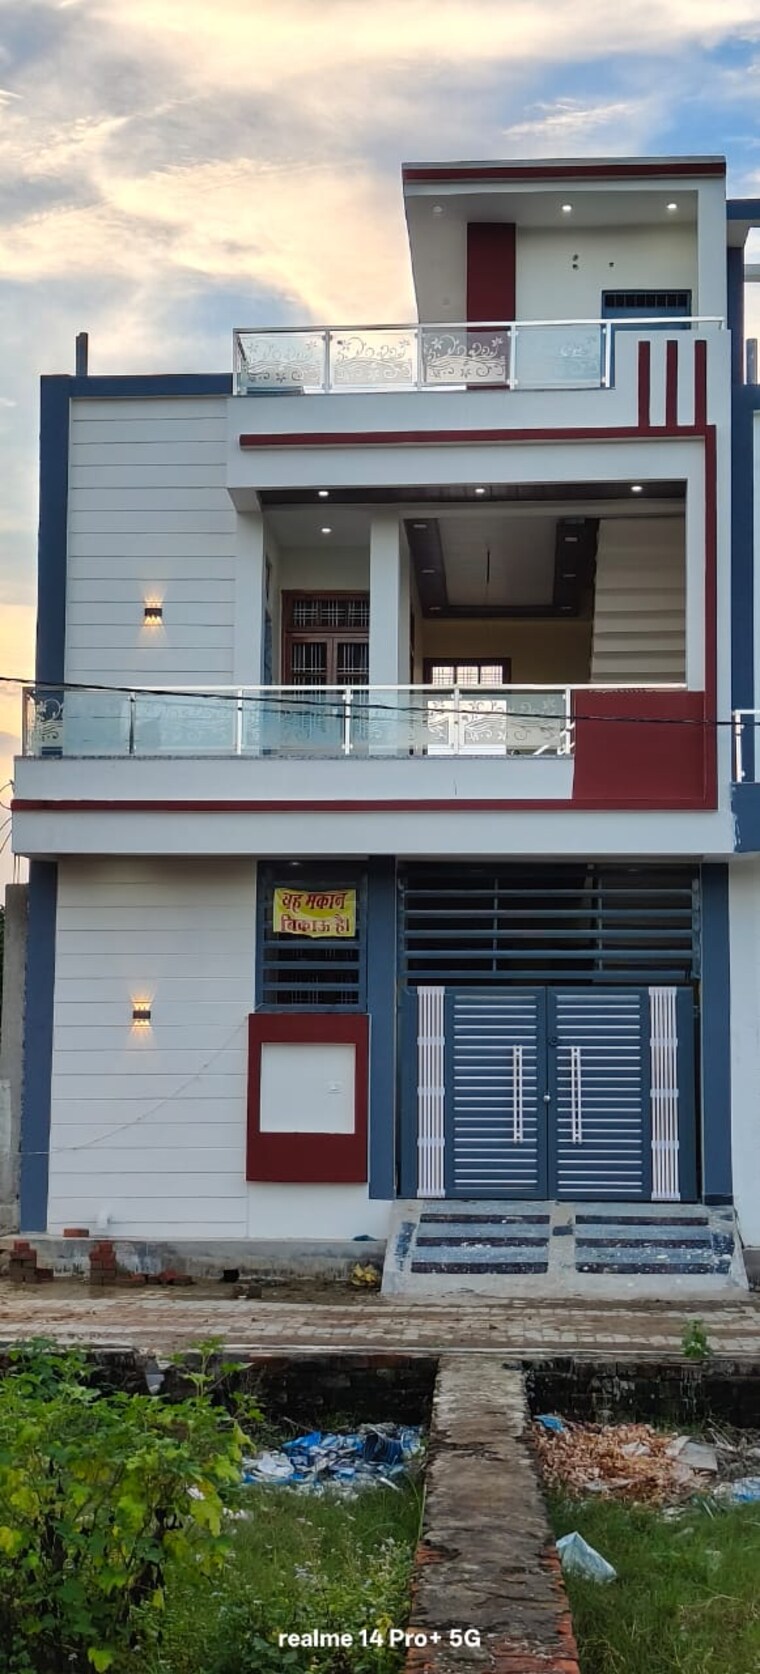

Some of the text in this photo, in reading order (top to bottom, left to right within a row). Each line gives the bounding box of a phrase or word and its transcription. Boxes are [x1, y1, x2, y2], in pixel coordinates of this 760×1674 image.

[282, 892, 348, 912] यह मकान
[280, 913, 330, 932] बिकाऊ
